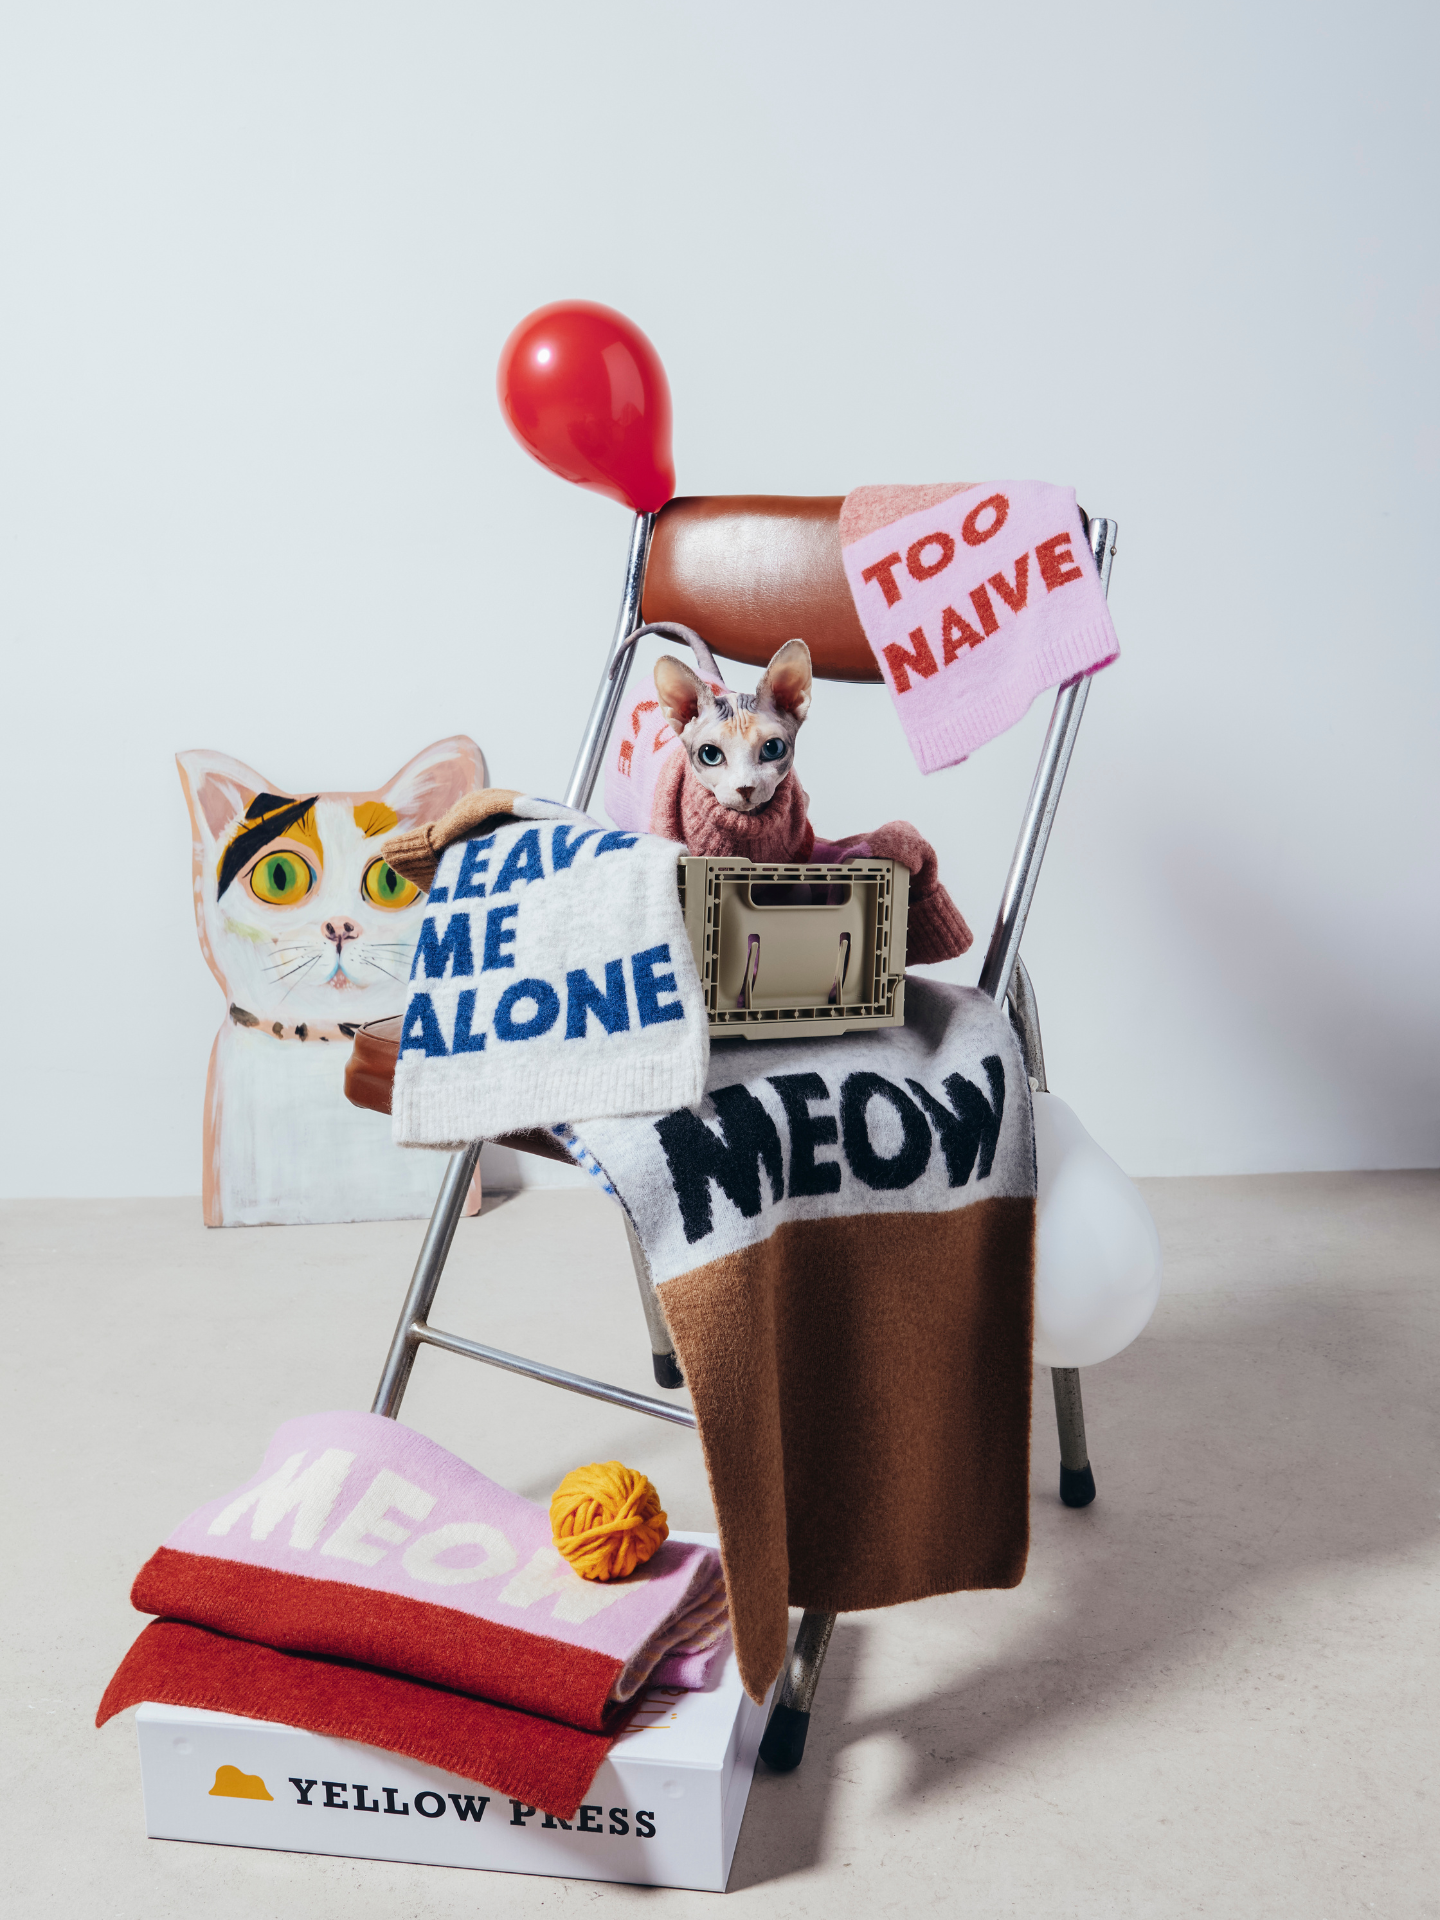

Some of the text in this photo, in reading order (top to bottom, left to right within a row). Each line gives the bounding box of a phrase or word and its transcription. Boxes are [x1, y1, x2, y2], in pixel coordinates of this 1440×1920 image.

[861, 493, 1010, 609] TOO
[882, 532, 1083, 695] NAIVE
[409, 904, 520, 981] ME
[397, 944, 685, 1061] ALONE
[654, 1055, 1005, 1245] MEOW
[206, 1447, 652, 1624] MEOW
[288, 1777, 491, 1823] YELLOW
